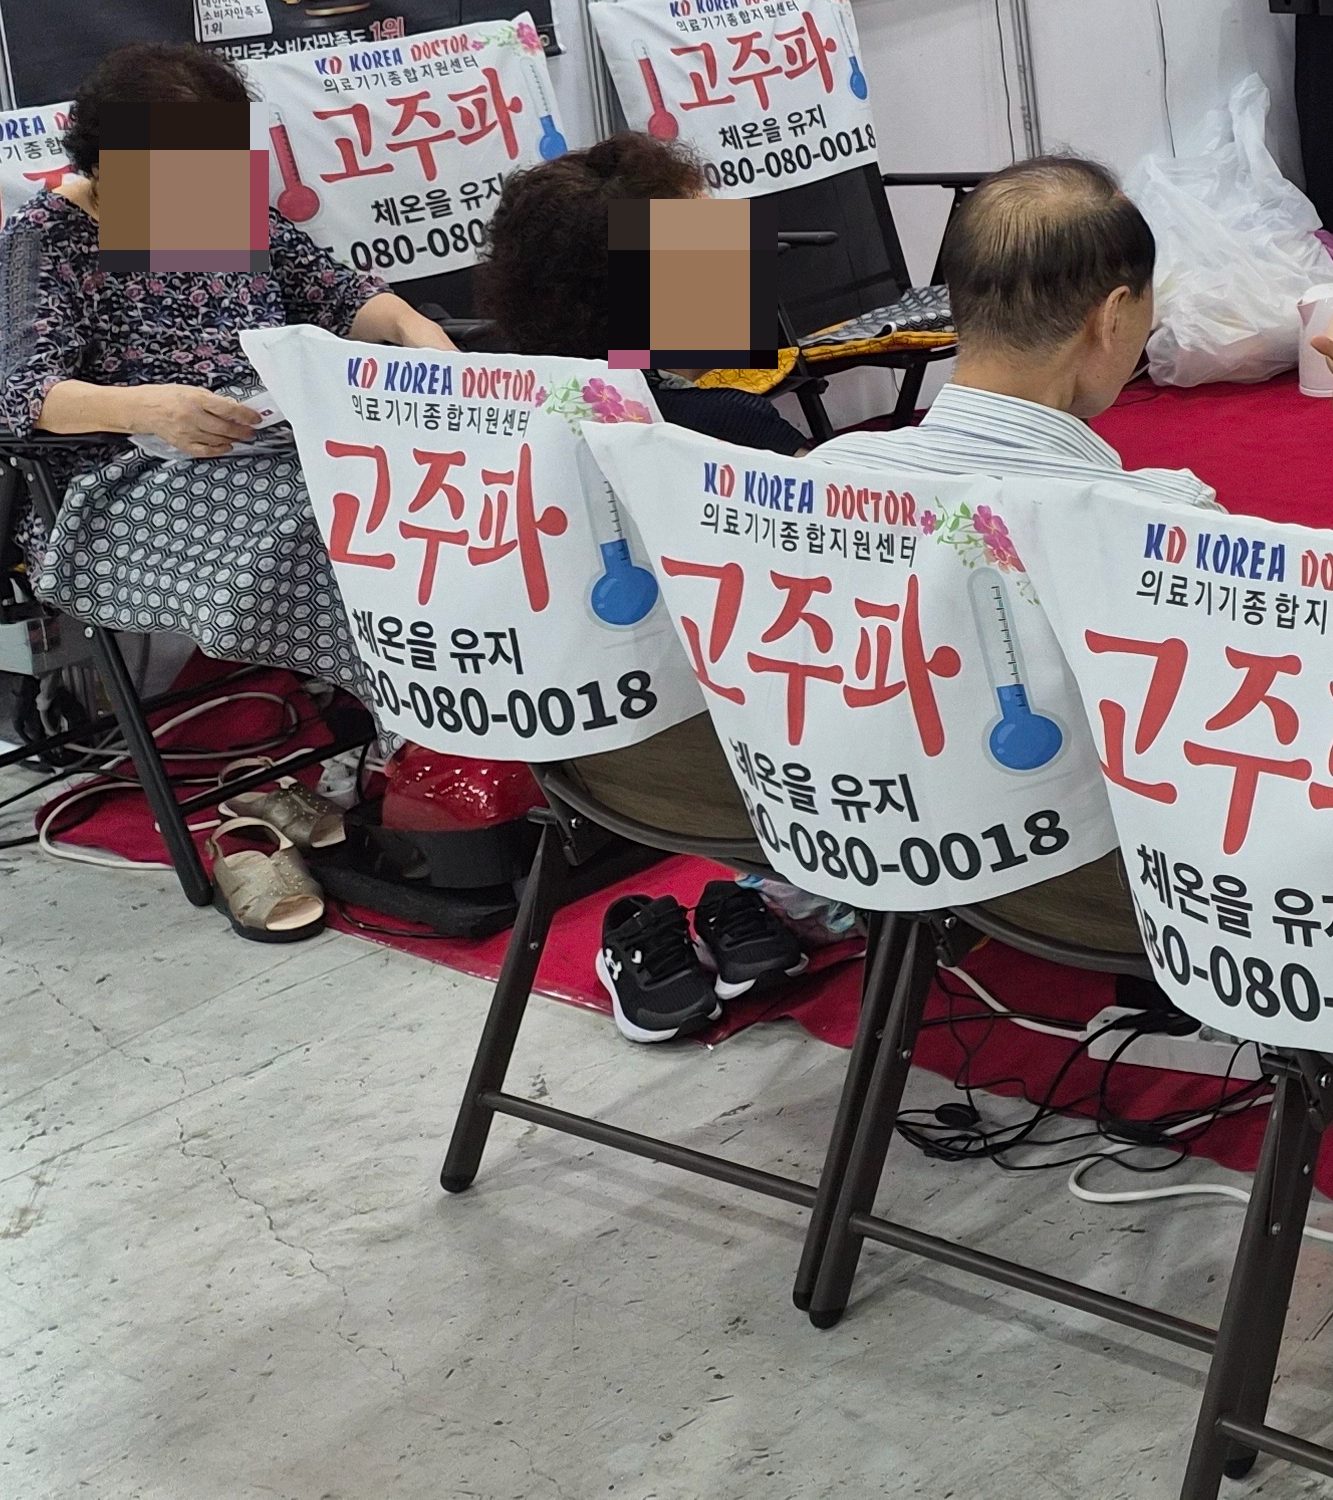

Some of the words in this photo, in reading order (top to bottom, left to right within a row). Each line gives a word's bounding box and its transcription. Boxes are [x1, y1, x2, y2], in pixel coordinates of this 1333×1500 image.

[676, 0, 800, 33] 의료기기종합지원센터
[314, 55, 343, 76] KD
[350, 47, 403, 74] KOREA
[410, 33, 470, 62] DOCTOR
[323, 54, 480, 94] 의료기기종합지원센터
[670, 10, 838, 112] 고주파
[312, 66, 523, 183] 고주파
[718, 116, 782, 152] 체온을
[787, 103, 828, 138] 유지
[371, 188, 454, 227] 체온을
[347, 356, 379, 390] KD
[384, 360, 453, 397] KOREA
[461, 366, 537, 402] DOCTOR
[351, 393, 532, 439] 의료기기종합지원센터
[703, 462, 736, 497] KD
[744, 469, 815, 515] KOREA
[825, 482, 919, 528] DOCTOR
[325, 439, 569, 613] 고주파
[700, 502, 919, 568] 의료기기종합지원센터
[1144, 523, 1189, 565] KD
[1196, 529, 1287, 583] KOREA
[351, 607, 438, 672] 체온을
[448, 627, 524, 676] 유지
[660, 555, 962, 758] 고주파
[830, 773, 921, 824] 유지
[1137, 842, 1254, 939] 체온을
